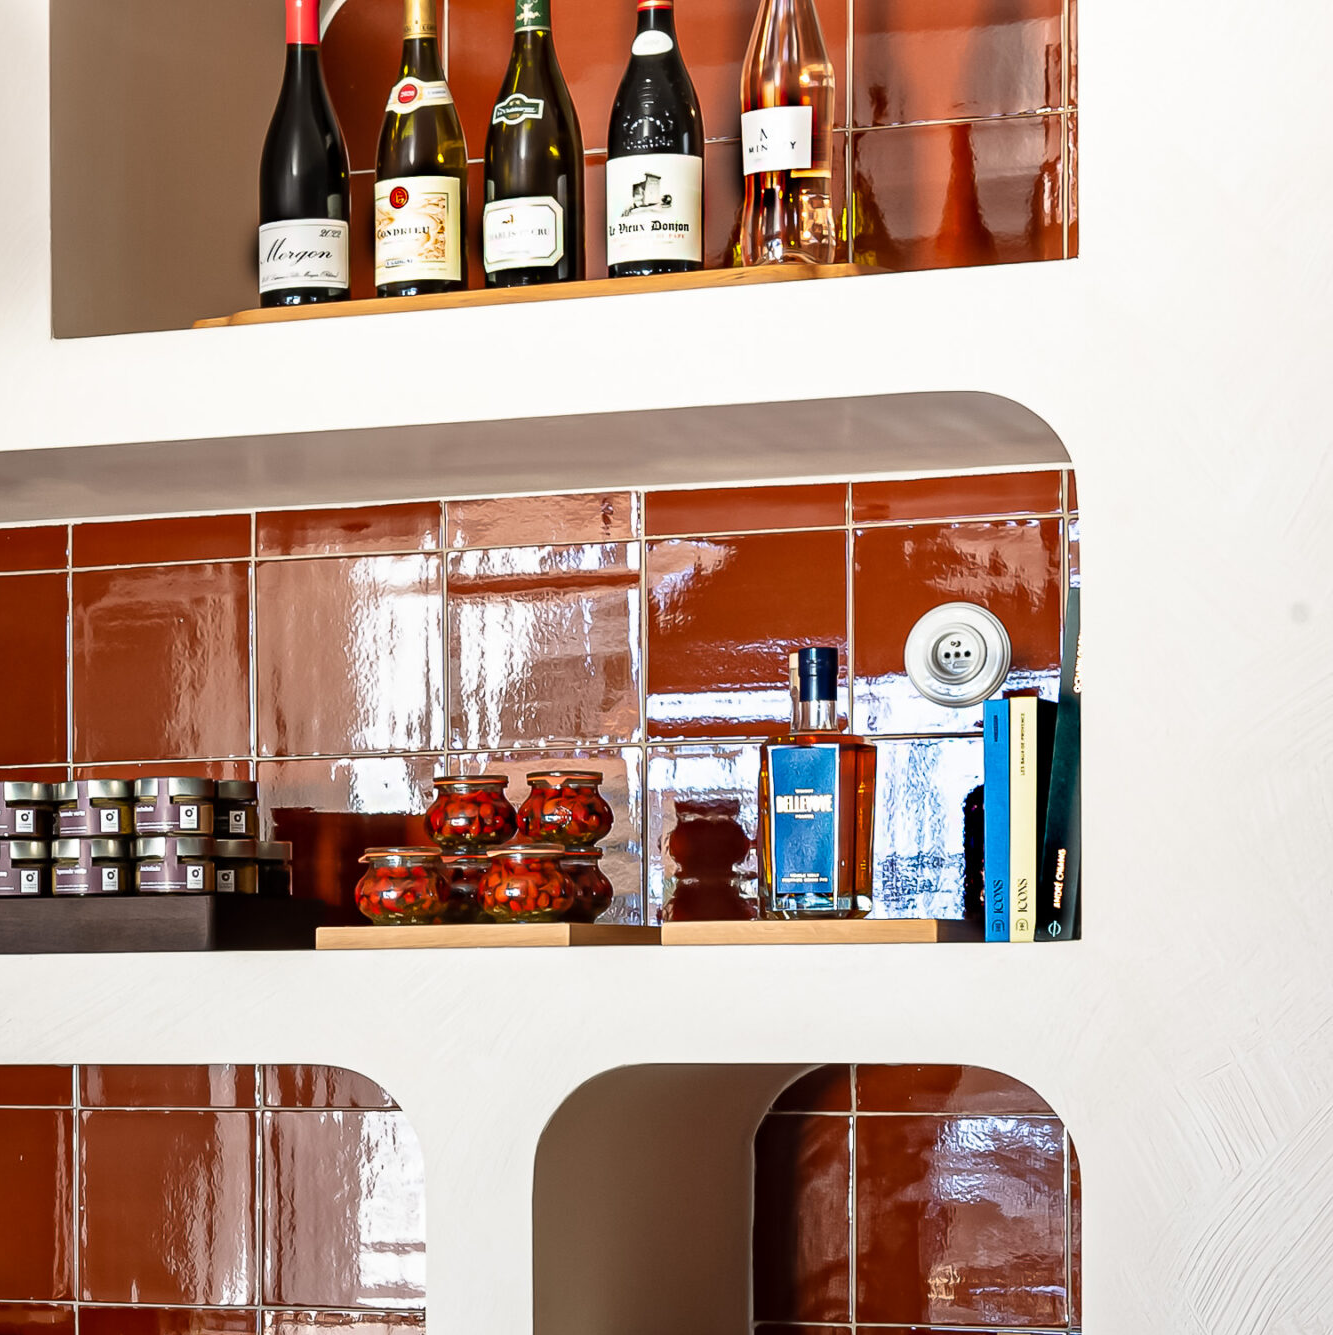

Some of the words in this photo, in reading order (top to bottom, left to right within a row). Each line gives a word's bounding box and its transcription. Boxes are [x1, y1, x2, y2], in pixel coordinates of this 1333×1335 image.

[748, 141, 797, 153] MINY
[651, 220, 690, 232] Donjon
[259, 237, 334, 266] Morgon
[993, 879, 1004, 914] ICONS
[1017, 878, 1028, 912] ICONS
